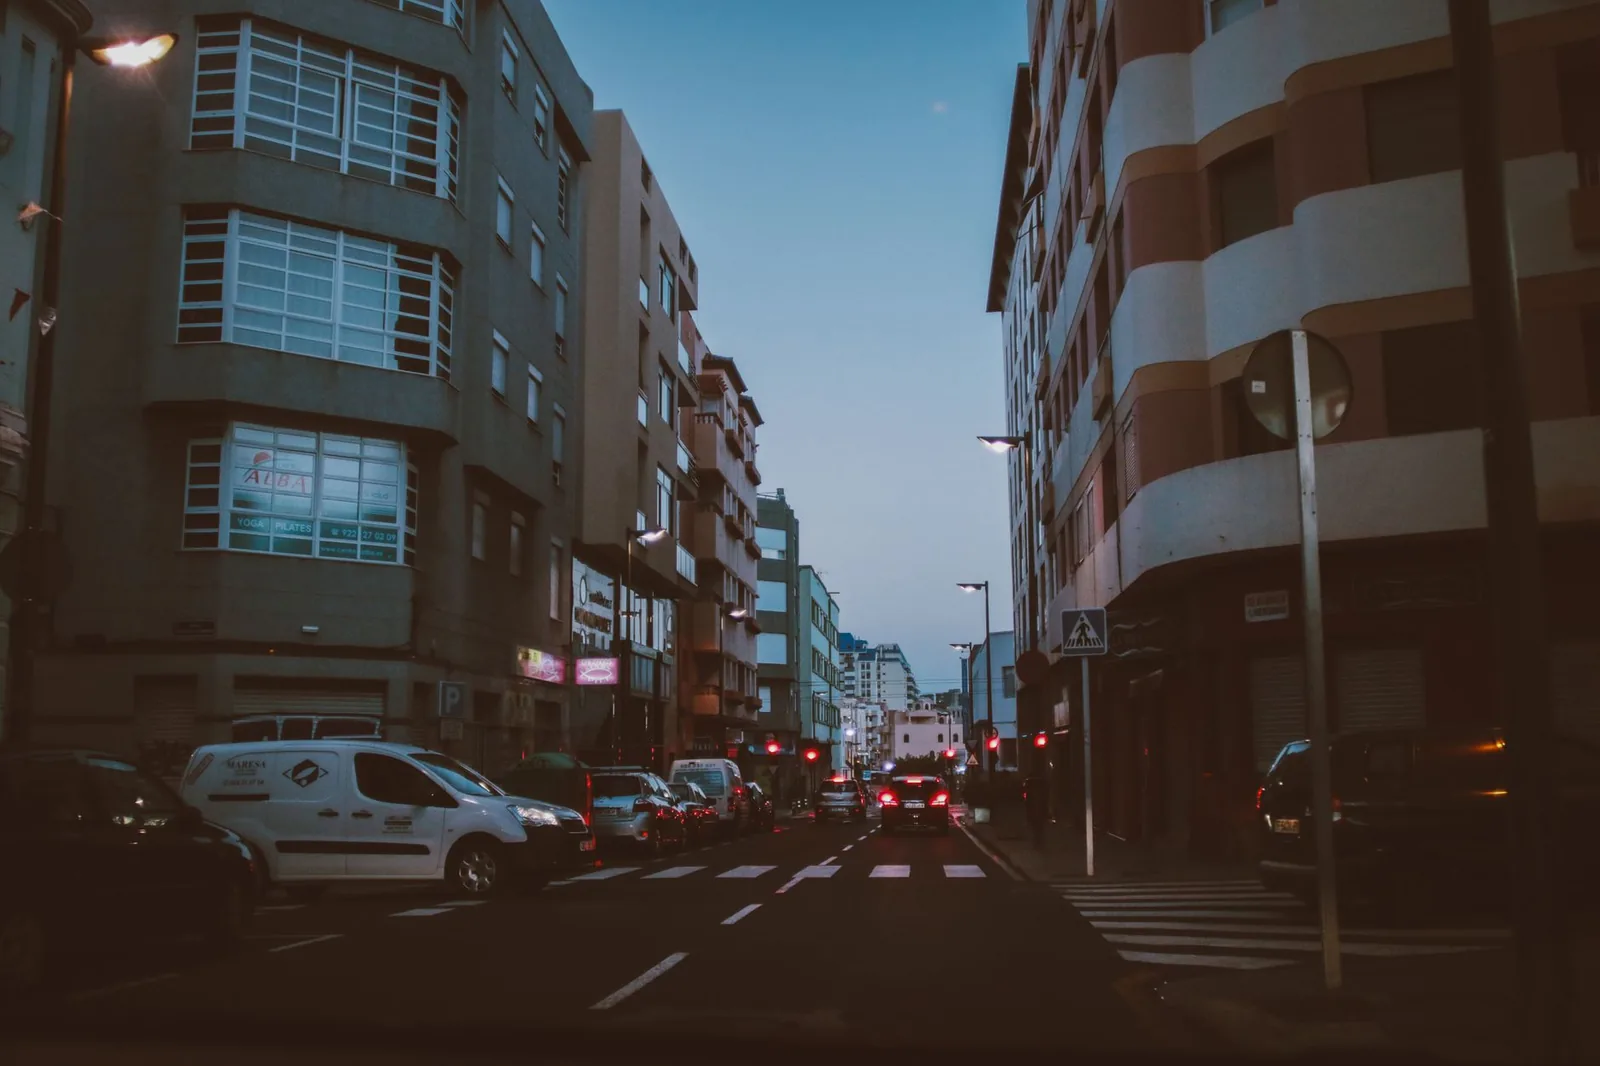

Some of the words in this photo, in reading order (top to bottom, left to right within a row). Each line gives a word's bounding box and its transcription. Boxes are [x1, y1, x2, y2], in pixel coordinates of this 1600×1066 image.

[243, 469, 306, 494] ALBA
[237, 517, 265, 528] YOGA
[275, 522, 312, 533] PILATES
[342, 529, 357, 538] 922
[446, 686, 461, 713] P
